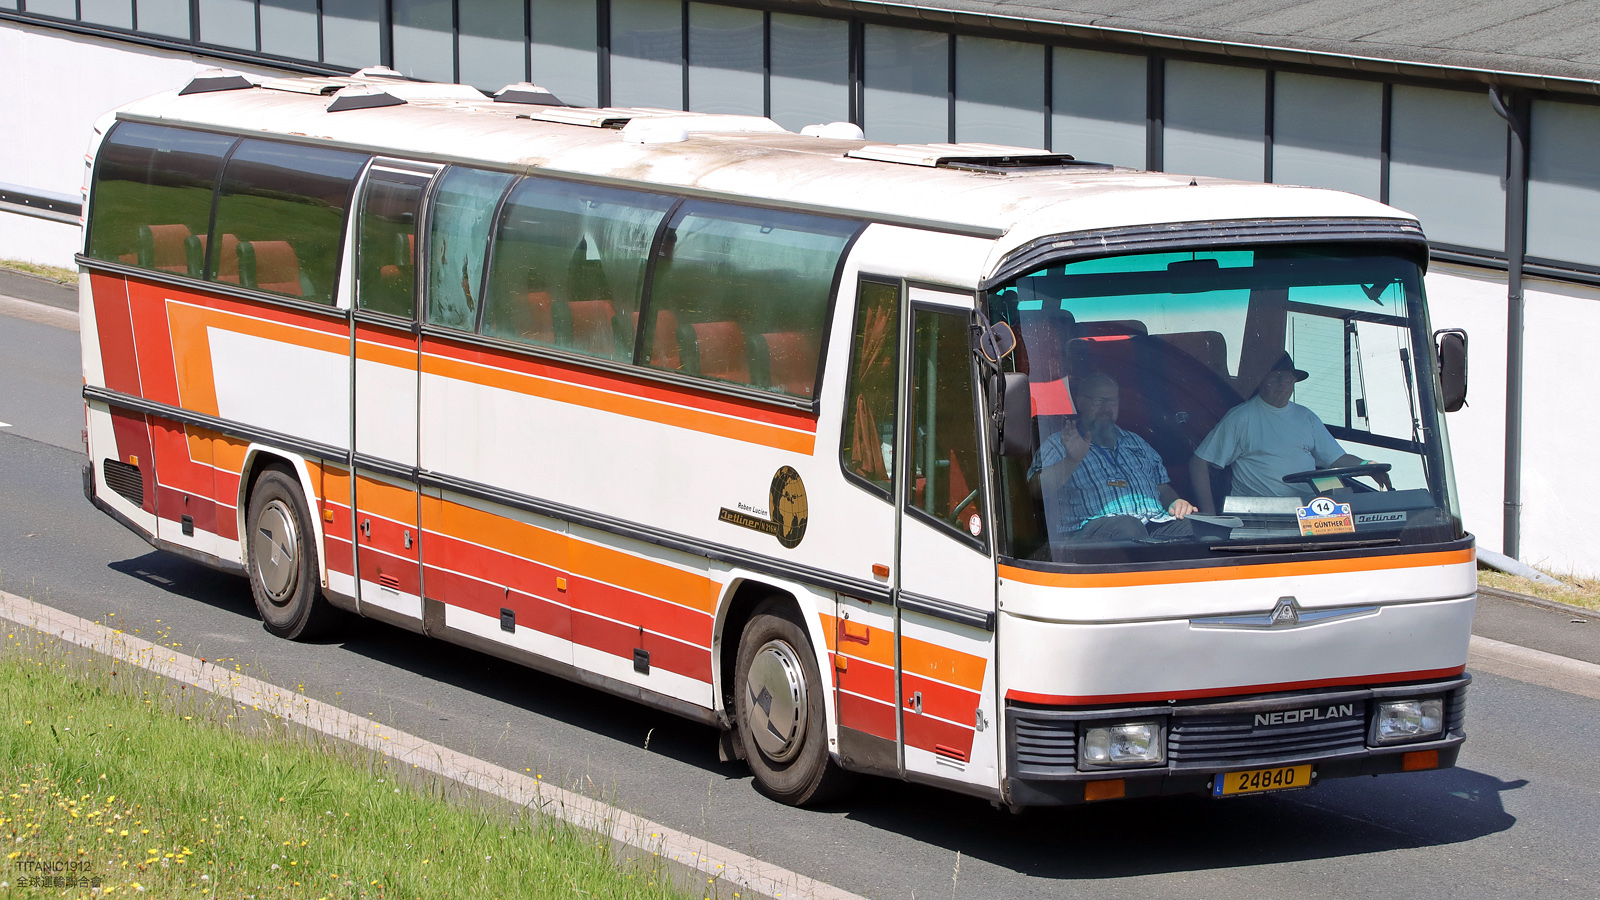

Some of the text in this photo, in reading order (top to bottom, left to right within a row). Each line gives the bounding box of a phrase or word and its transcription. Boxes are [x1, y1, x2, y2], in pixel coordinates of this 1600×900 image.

[752, 506, 768, 516] Lucien
[1316, 502, 1330, 512] 14
[720, 510, 760, 528] Jetliner
[1358, 514, 1403, 523] Jetliner
[1314, 520, 1343, 529] GÜNTHER
[1254, 704, 1353, 726] NEOPLAN
[1238, 768, 1295, 790] 24840
